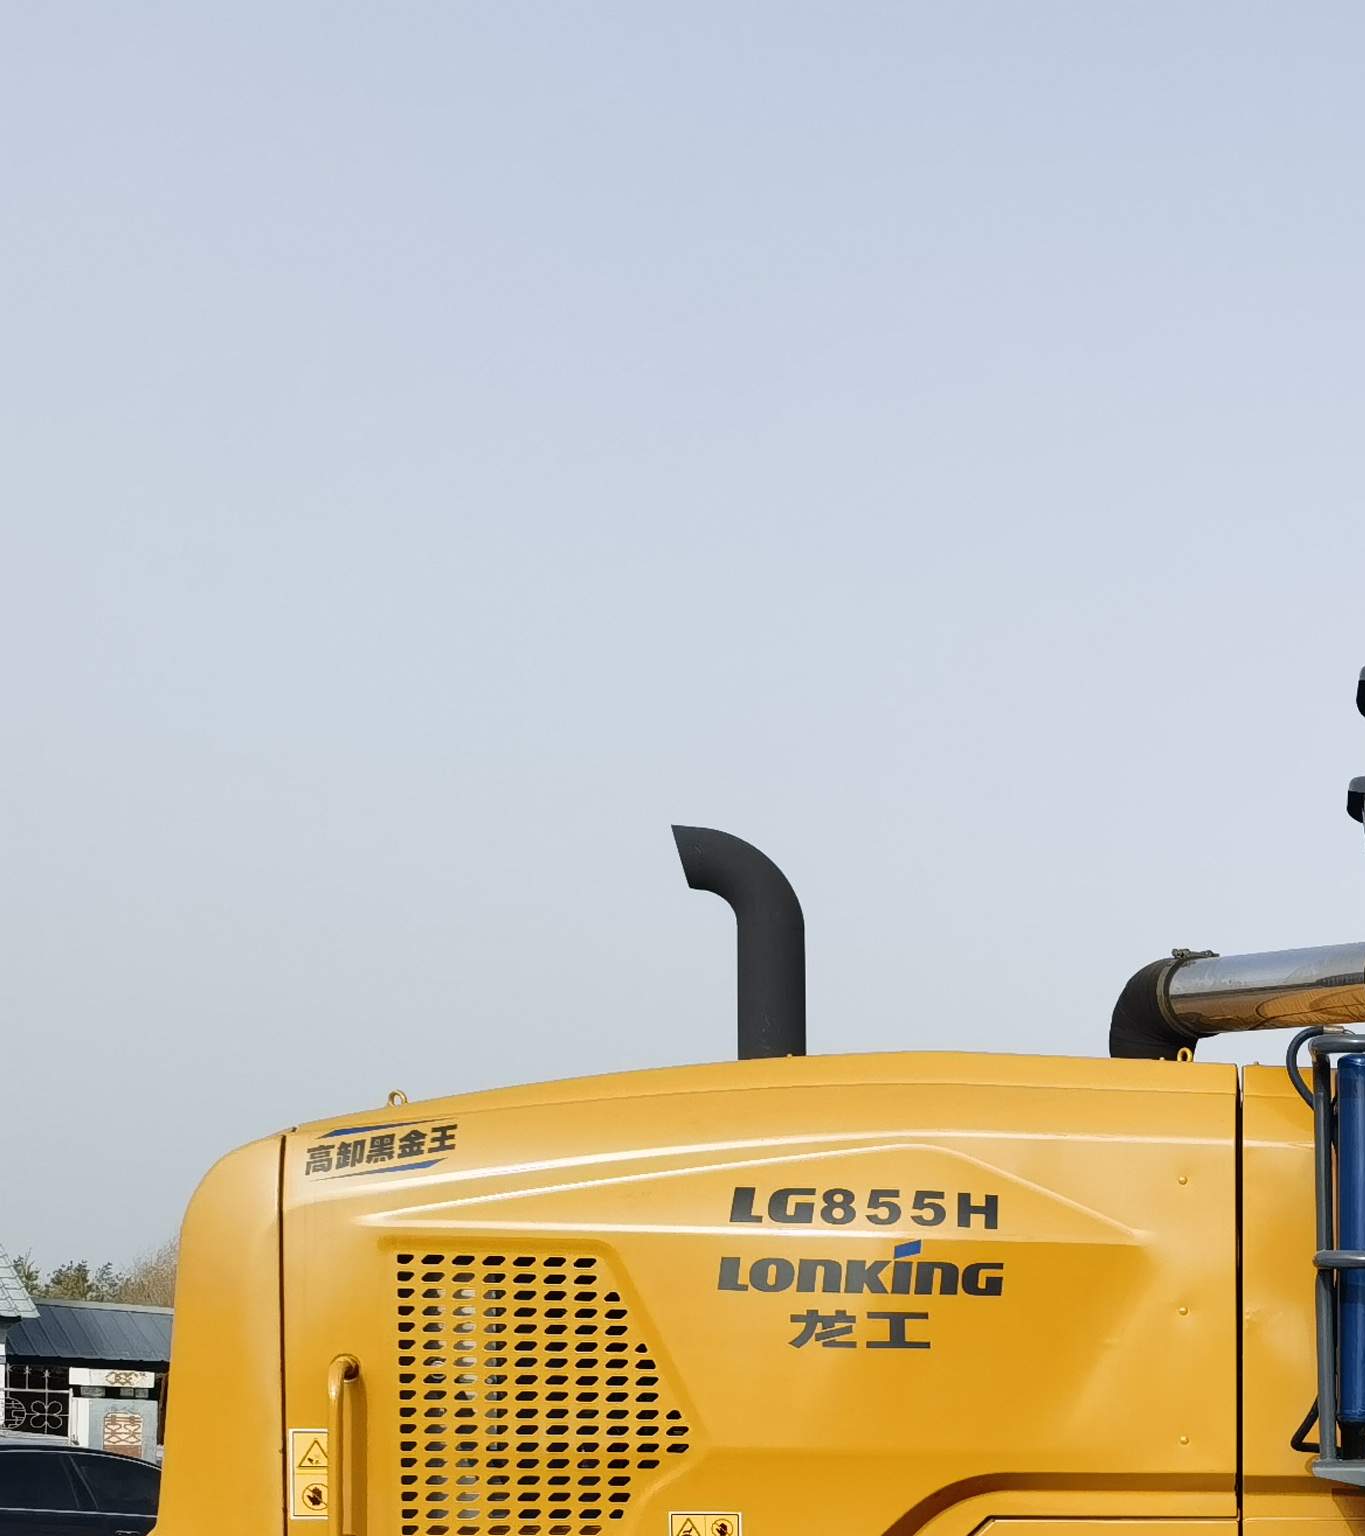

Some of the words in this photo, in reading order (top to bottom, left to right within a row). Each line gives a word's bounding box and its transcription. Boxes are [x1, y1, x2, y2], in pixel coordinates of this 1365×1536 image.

[304, 1123, 458, 1176] 高卸黑金王
[729, 1187, 999, 1230] LG855H
[788, 1310, 931, 1350] 龙工
